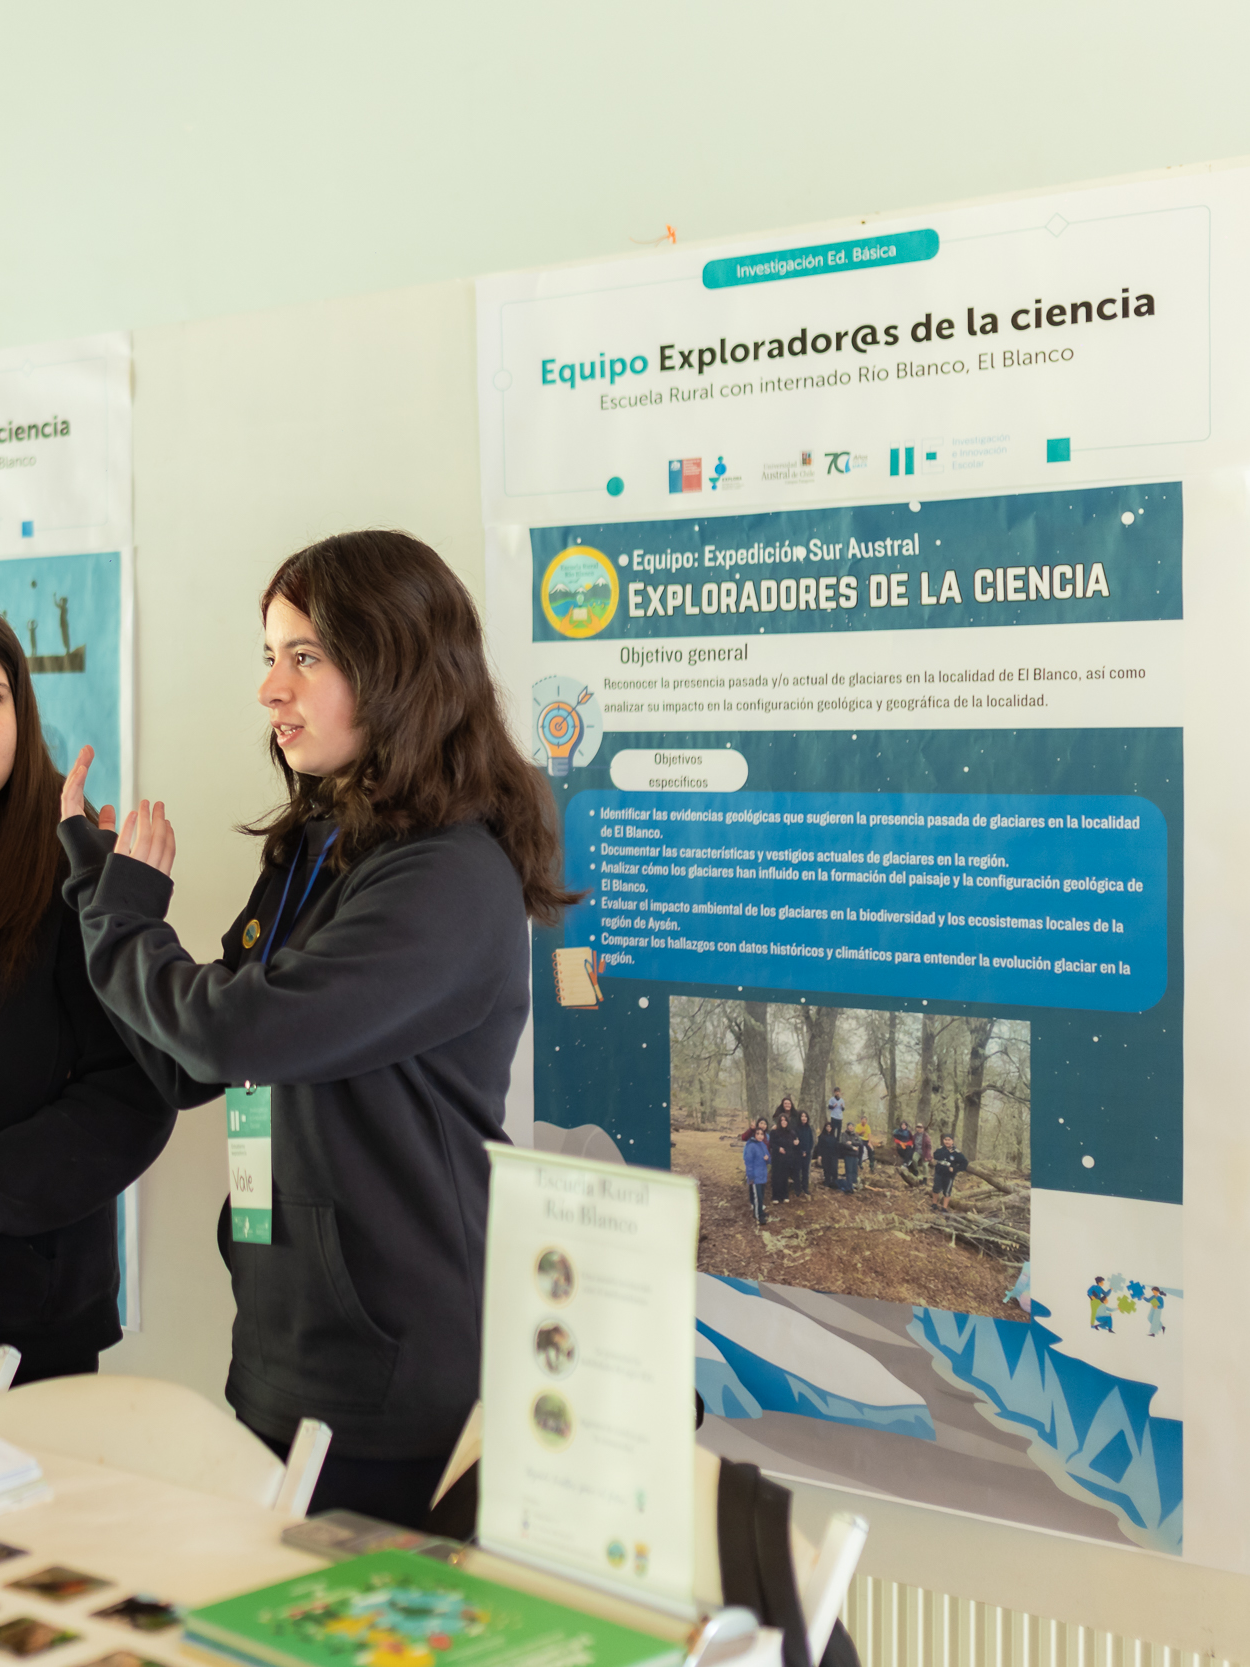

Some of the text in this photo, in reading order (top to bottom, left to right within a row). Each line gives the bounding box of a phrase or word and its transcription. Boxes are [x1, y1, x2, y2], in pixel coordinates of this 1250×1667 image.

[736, 244, 896, 278] Investigación Ed. Básica
[542, 288, 1154, 389] Equipo Explorador@s de la ciencia
[600, 348, 1074, 410] Escuela Rural con internado Río Blanco, El Blanco
[633, 532, 919, 573] Equipo: Expedición Sur Austral
[628, 562, 1109, 617] EXPLORADORES DE LA CIENCIA
[620, 643, 747, 667] Objetivo general
[604, 665, 1145, 690] Reconocer la presencia pasada y/o actual de glaciares en la localidad de El Blanco, así como
[604, 693, 1048, 714] analizar su impacto en la configuración geológica y geográfica de la localidad.
[654, 752, 702, 767] Objetivos
[648, 776, 708, 790] específicos
[600, 807, 1140, 829] Identificar las evidencias geológicas que sugieren la presencia pasada de glaciares en la localidad
[600, 825, 663, 838] de El Blanco.
[600, 842, 1008, 869] Documentar las características y vestigios actuales de glaciares en la región.
[600, 860, 1143, 894] Analizar cómo los glaciares han influido en la formación del paisaje y la configuración geológica de
[601, 878, 648, 892] El Blanco.
[601, 896, 1124, 933] Evaluar el impacto ambiental de los glaciares en la biodiversidad y los ecosistemas locales de la
[601, 915, 680, 932] región de Aysén.
[600, 951, 635, 966] región.
[601, 932, 1130, 975] Comparar los hallazgos con datos históricos y climáticos para entender la evolución glaciar en la
[232, 1167, 254, 1192] Vale
[580, 1204, 638, 1234] Blanco
